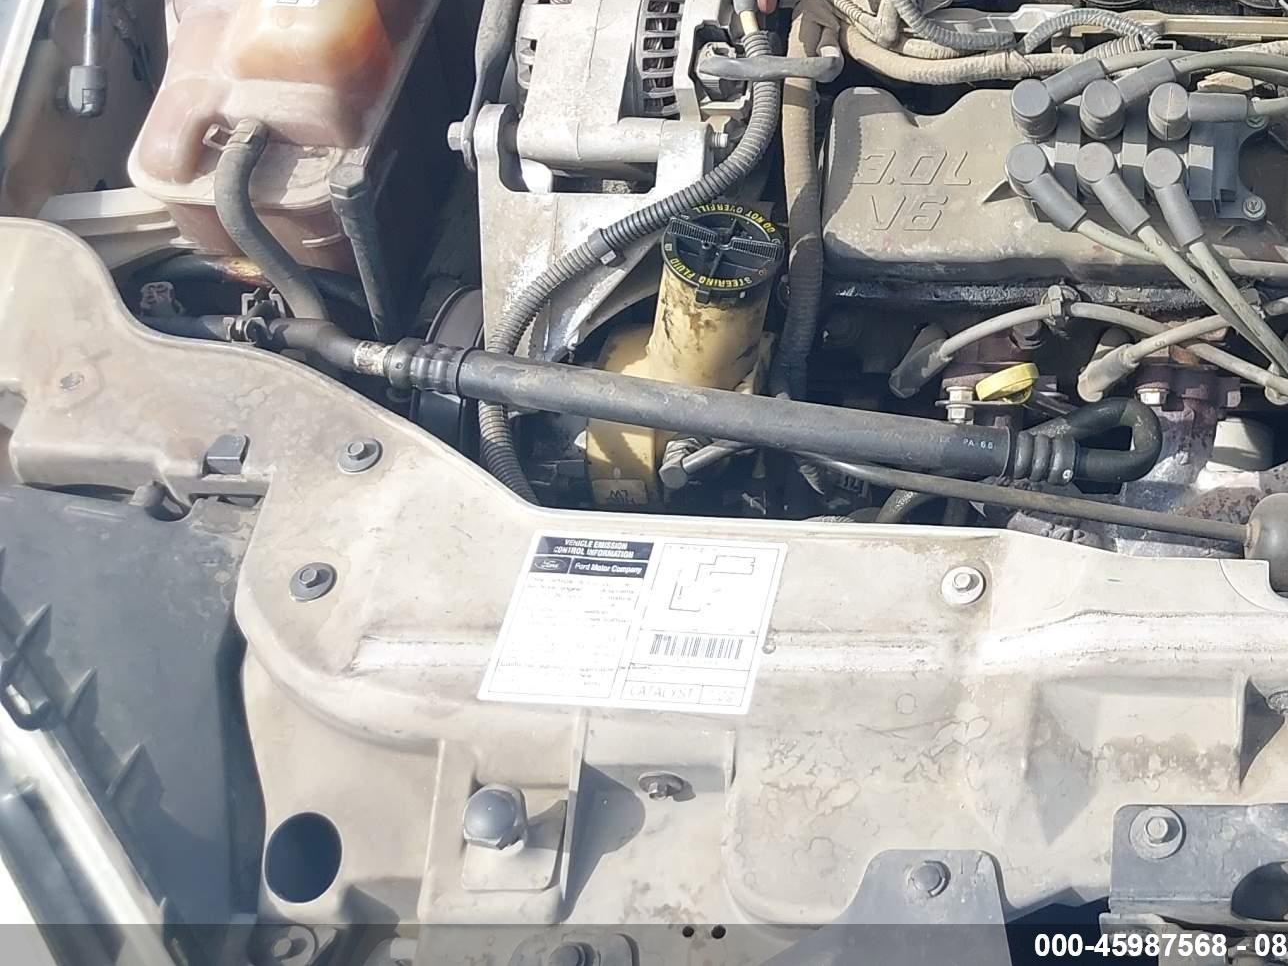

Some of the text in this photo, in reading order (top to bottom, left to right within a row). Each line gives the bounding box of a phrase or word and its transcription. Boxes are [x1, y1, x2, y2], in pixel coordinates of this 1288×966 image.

[692, 202, 744, 214] OVERFILL
[871, 196, 949, 232] V6
[745, 211, 764, 226] NOT
[669, 258, 753, 288] STEERING FLUID
[564, 539, 629, 550] VEHICLE EMISSION
[553, 546, 635, 558] CONTROL INFORMATION
[575, 562, 643, 575] Ford Motor Company
